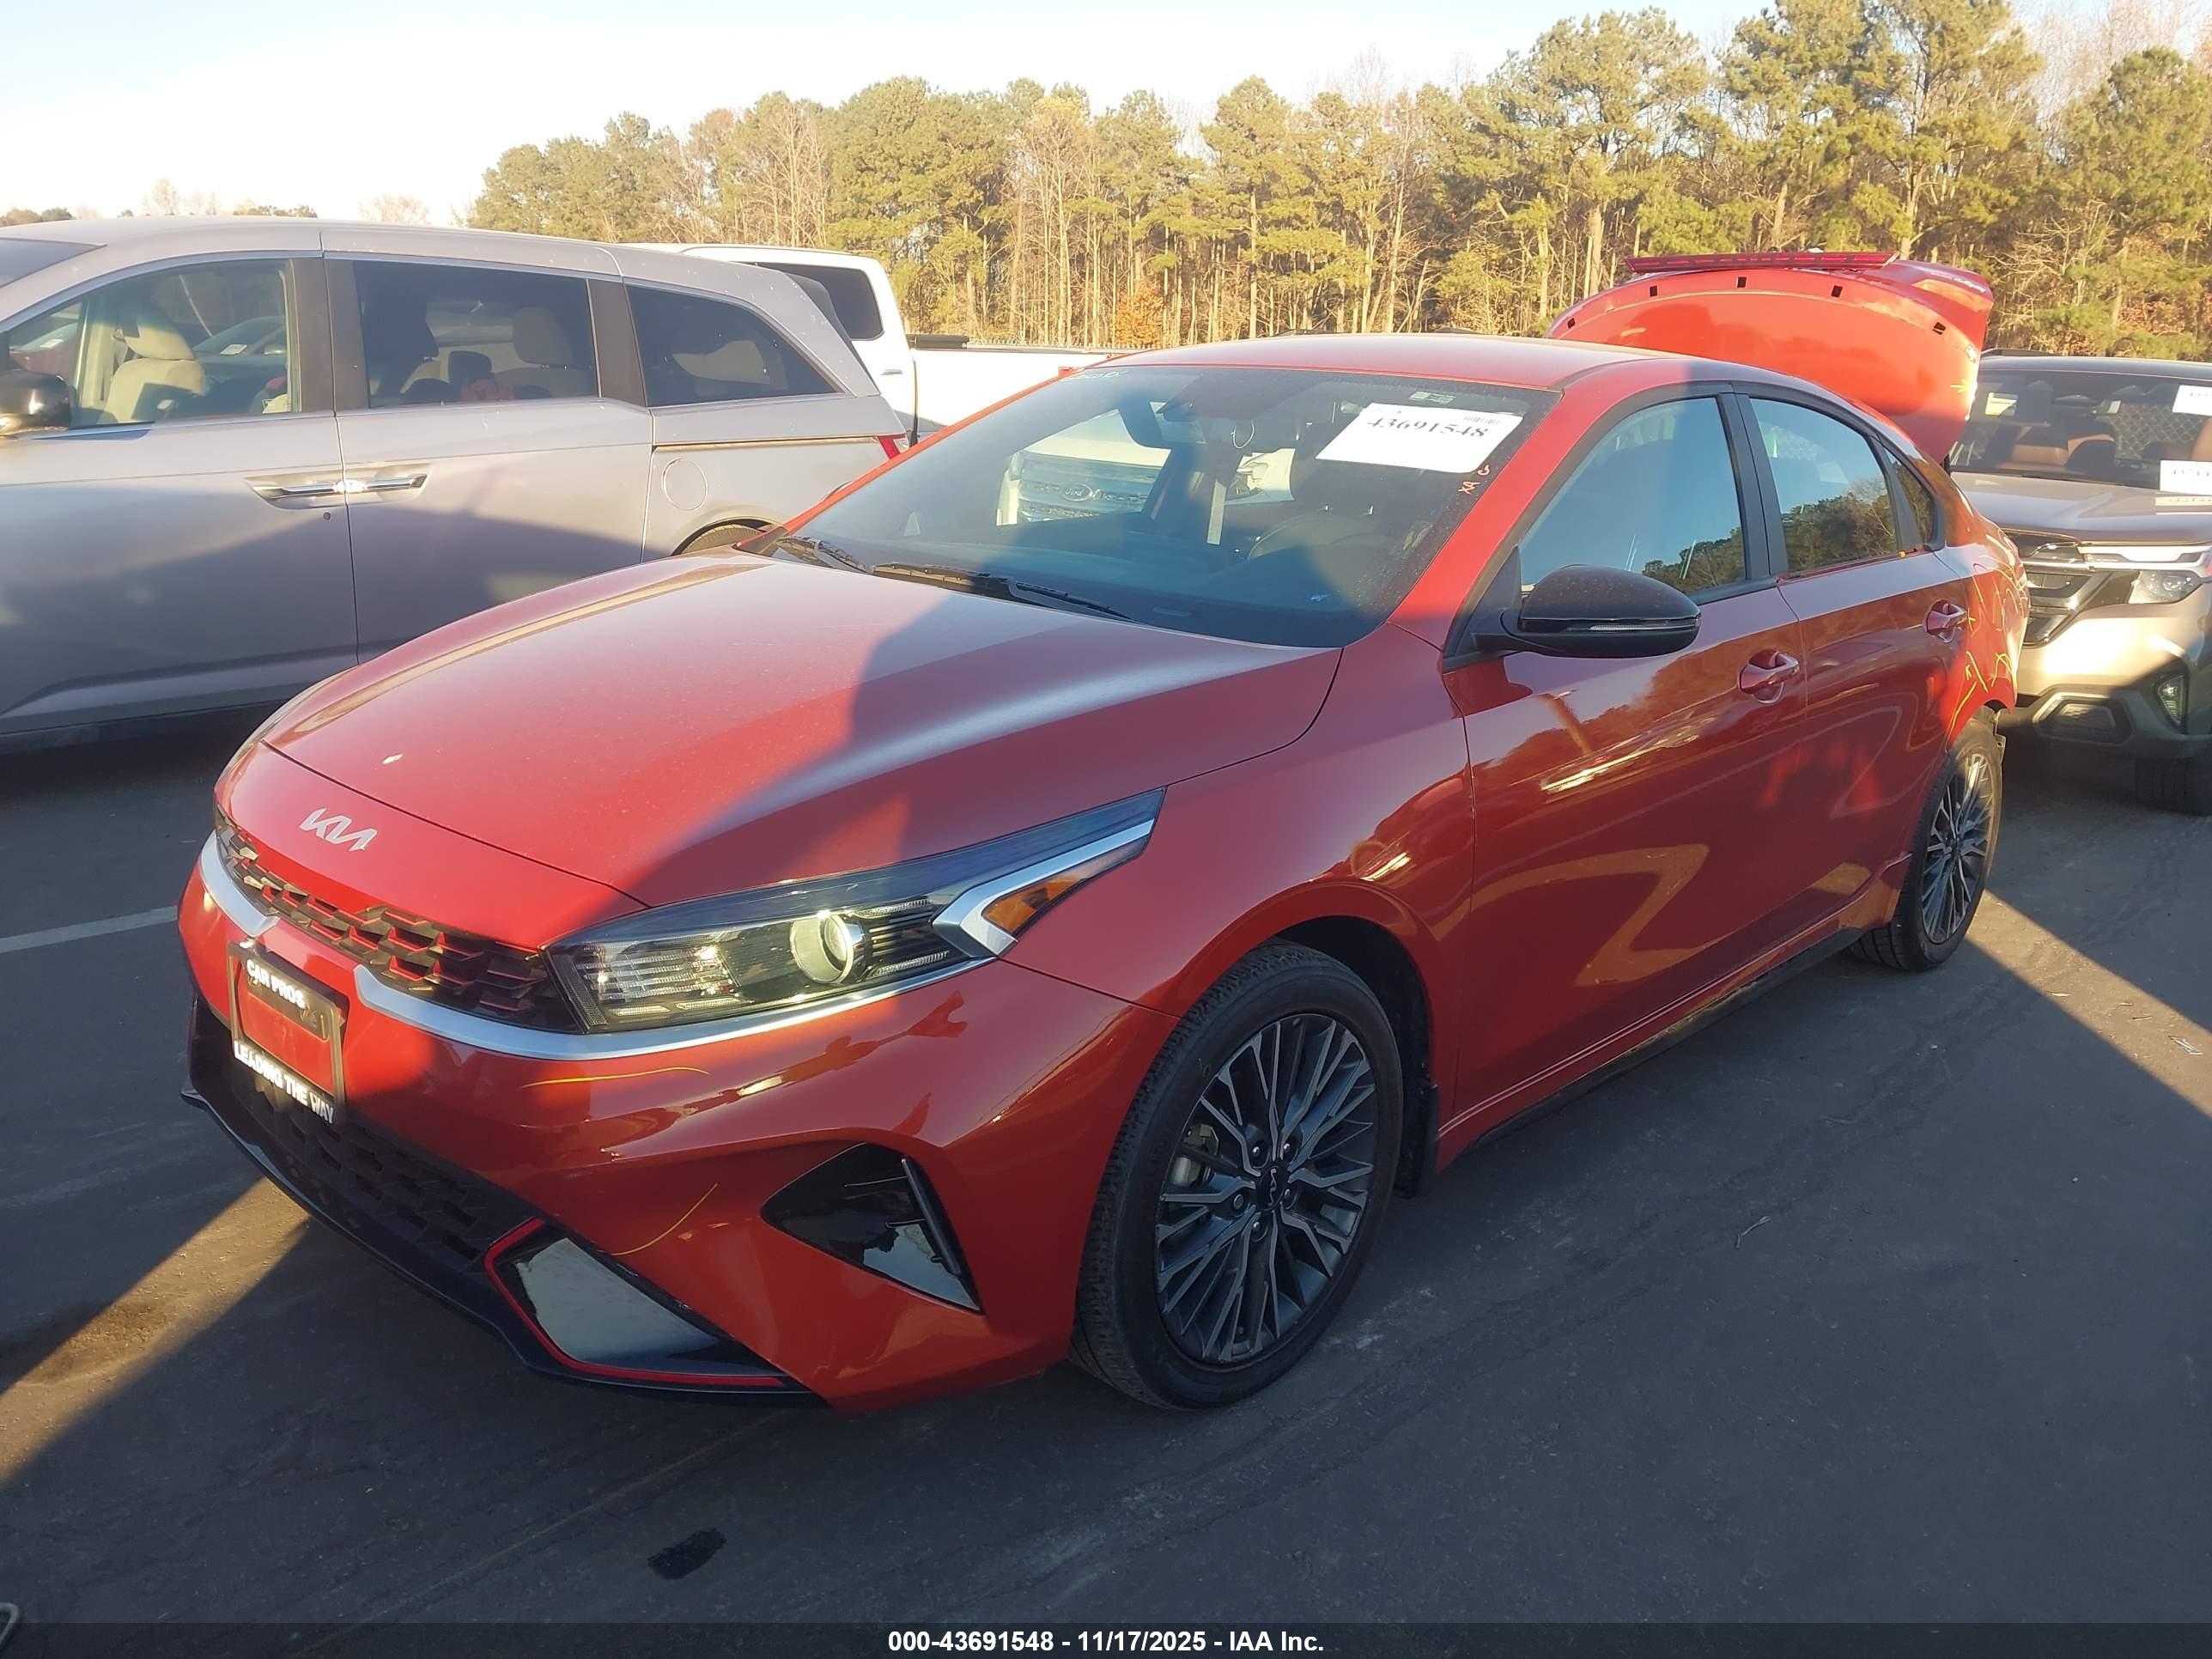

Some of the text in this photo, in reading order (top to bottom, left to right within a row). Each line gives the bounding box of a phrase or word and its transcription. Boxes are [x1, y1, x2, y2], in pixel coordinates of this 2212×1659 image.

[1367, 416, 1489, 438] 43691548
[299, 807, 378, 852] KIA
[246, 958, 306, 1009] CAR PROS
[234, 1040, 334, 1124] LEADING THE WAY
